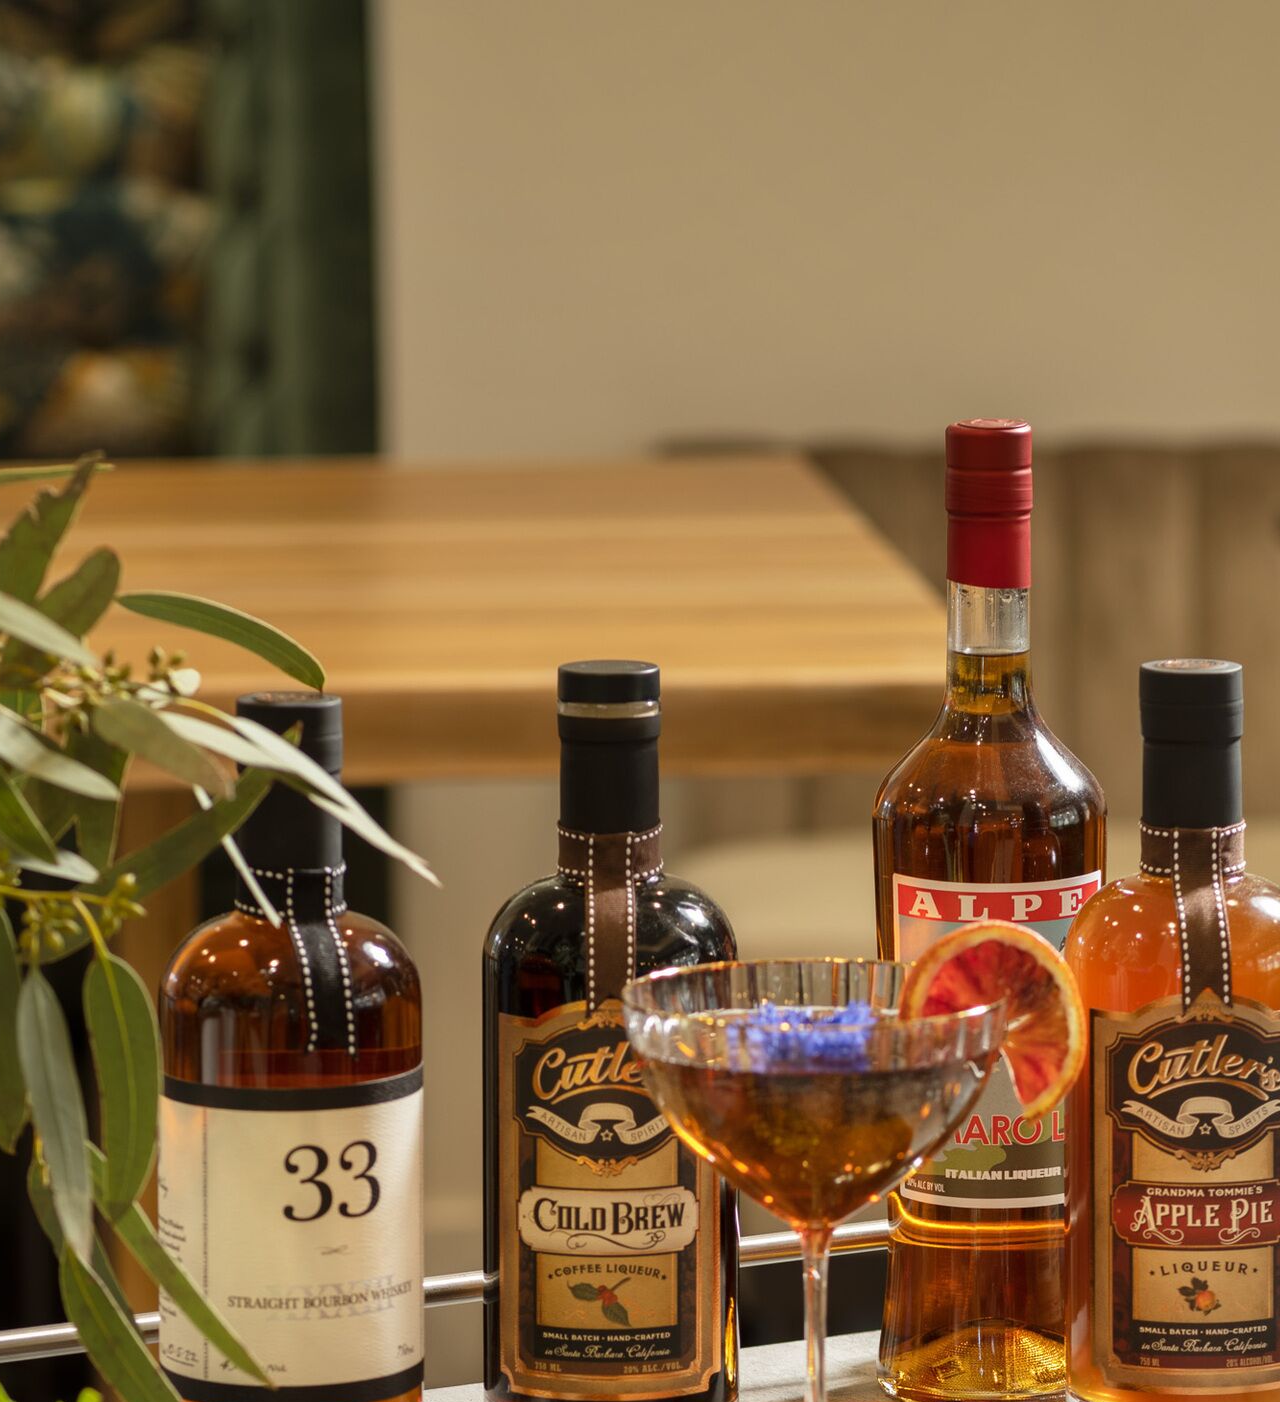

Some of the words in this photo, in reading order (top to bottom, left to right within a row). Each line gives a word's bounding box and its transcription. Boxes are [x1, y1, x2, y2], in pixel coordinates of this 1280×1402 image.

[908, 887, 1083, 921] ALPE
[532, 1040, 643, 1100] Cutle
[540, 1112, 587, 1142] ARTISAN
[630, 1116, 667, 1142] SPIRIT
[953, 1113, 1043, 1146] ARO
[1051, 1110, 1065, 1143] L
[1137, 1105, 1185, 1136] ARTISAN
[1228, 1106, 1269, 1136] SPIRITS
[283, 1140, 380, 1222] 33
[944, 1168, 1003, 1181] ITALIAN
[1004, 1166, 1062, 1182] LIQUEUR
[1146, 1187, 1205, 1197] GRANDMA
[1208, 1185, 1263, 1197] TOMMIE'S
[533, 1197, 607, 1232] COLD
[611, 1201, 685, 1235] BREW
[1129, 1195, 1220, 1233] APPLE
[1227, 1198, 1274, 1234] PIE
[554, 1264, 602, 1278] COFFEE
[606, 1264, 661, 1279] LIQUEUR
[1160, 1261, 1249, 1277] LIQUEUR
[228, 1295, 300, 1310] STRAIGHT
[303, 1291, 368, 1310] BOURBON
[542, 1331, 569, 1341] SMALL
[571, 1332, 600, 1342] BATCH
[607, 1331, 671, 1342] HAND-CRAFTED
[1139, 1326, 1167, 1335] SMALL
[1170, 1327, 1198, 1336] BATCH
[1205, 1325, 1268, 1336] HAND-CRAFTED
[554, 1344, 581, 1358] Santa
[626, 1344, 670, 1361] California
[1141, 1342, 1150, 1350] in
[1151, 1338, 1179, 1352] Santa
[1224, 1338, 1268, 1354] California
[549, 1363, 562, 1372] ML
